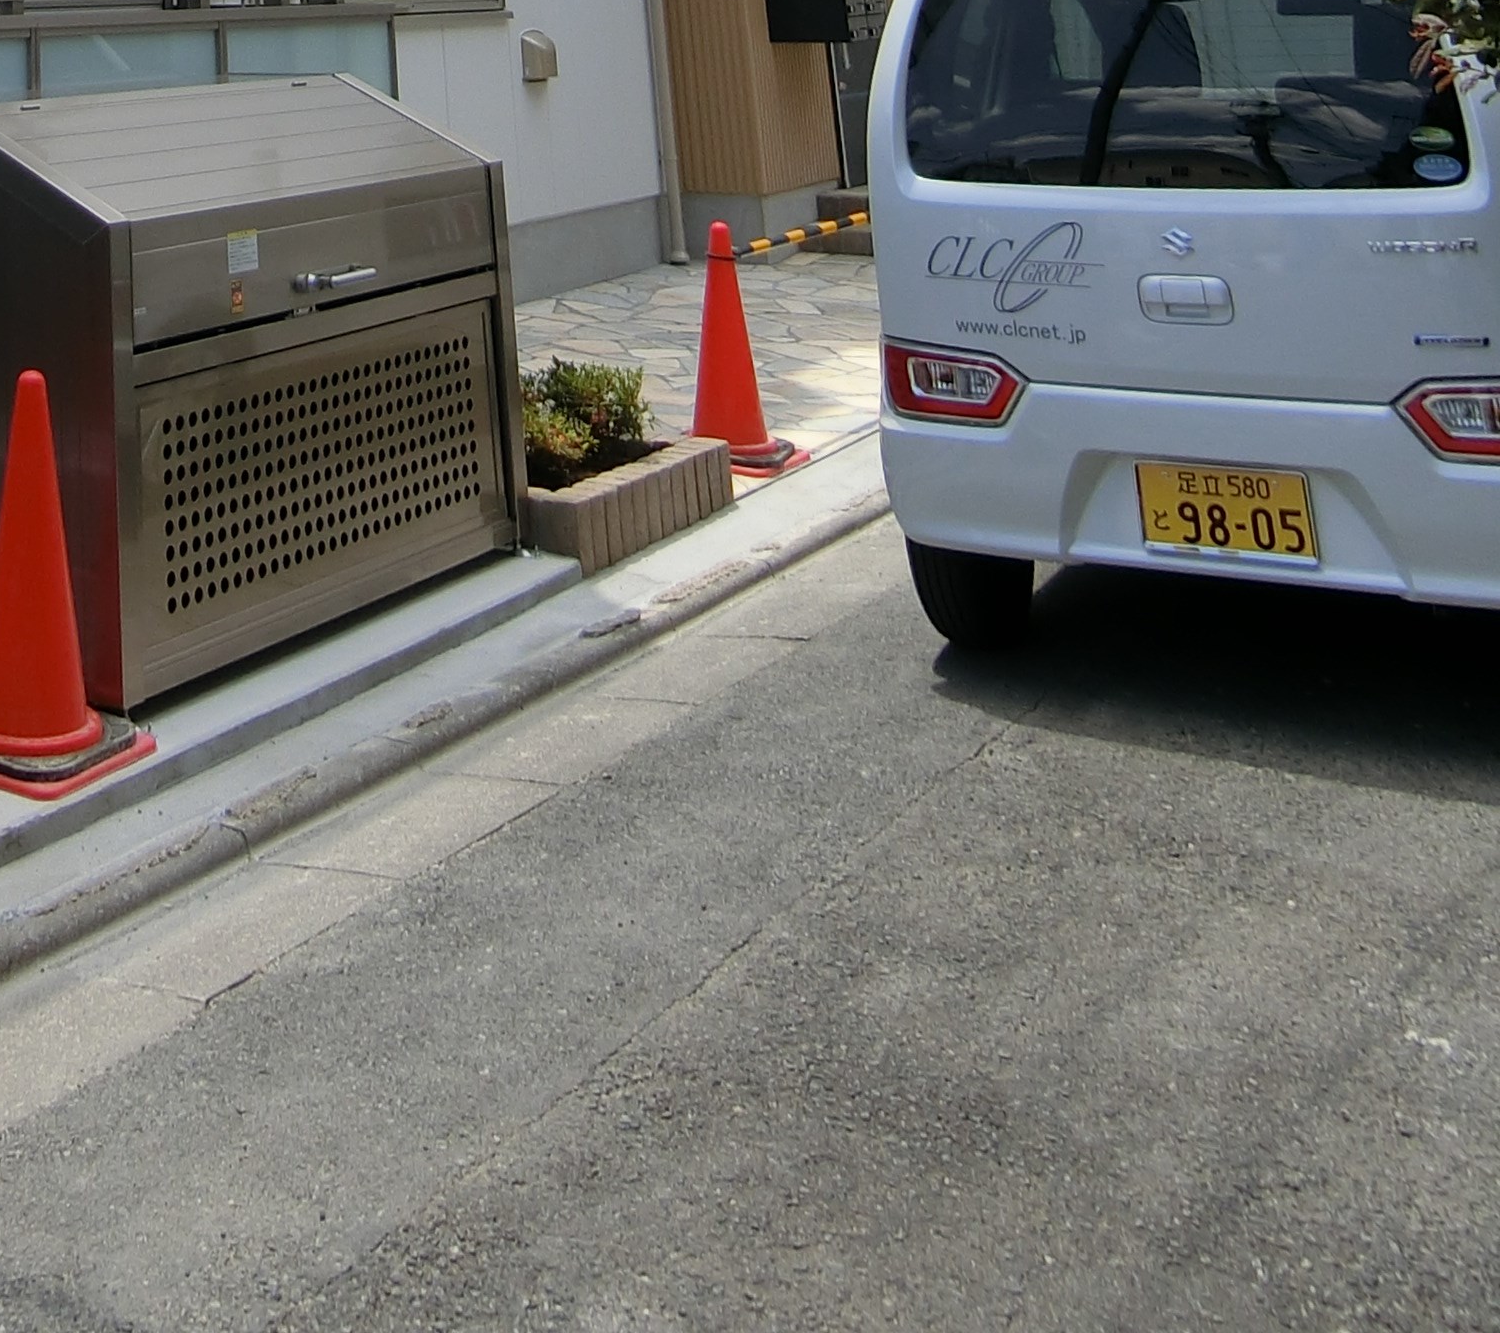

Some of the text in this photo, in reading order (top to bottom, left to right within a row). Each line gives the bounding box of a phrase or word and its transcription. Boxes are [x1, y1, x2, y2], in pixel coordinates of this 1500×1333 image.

[927, 235, 1015, 279] CLC
[1020, 263, 1085, 284] GROUP
[955, 319, 1086, 345] www.clcnet.jp
[1177, 501, 1306, 553] 98-05
